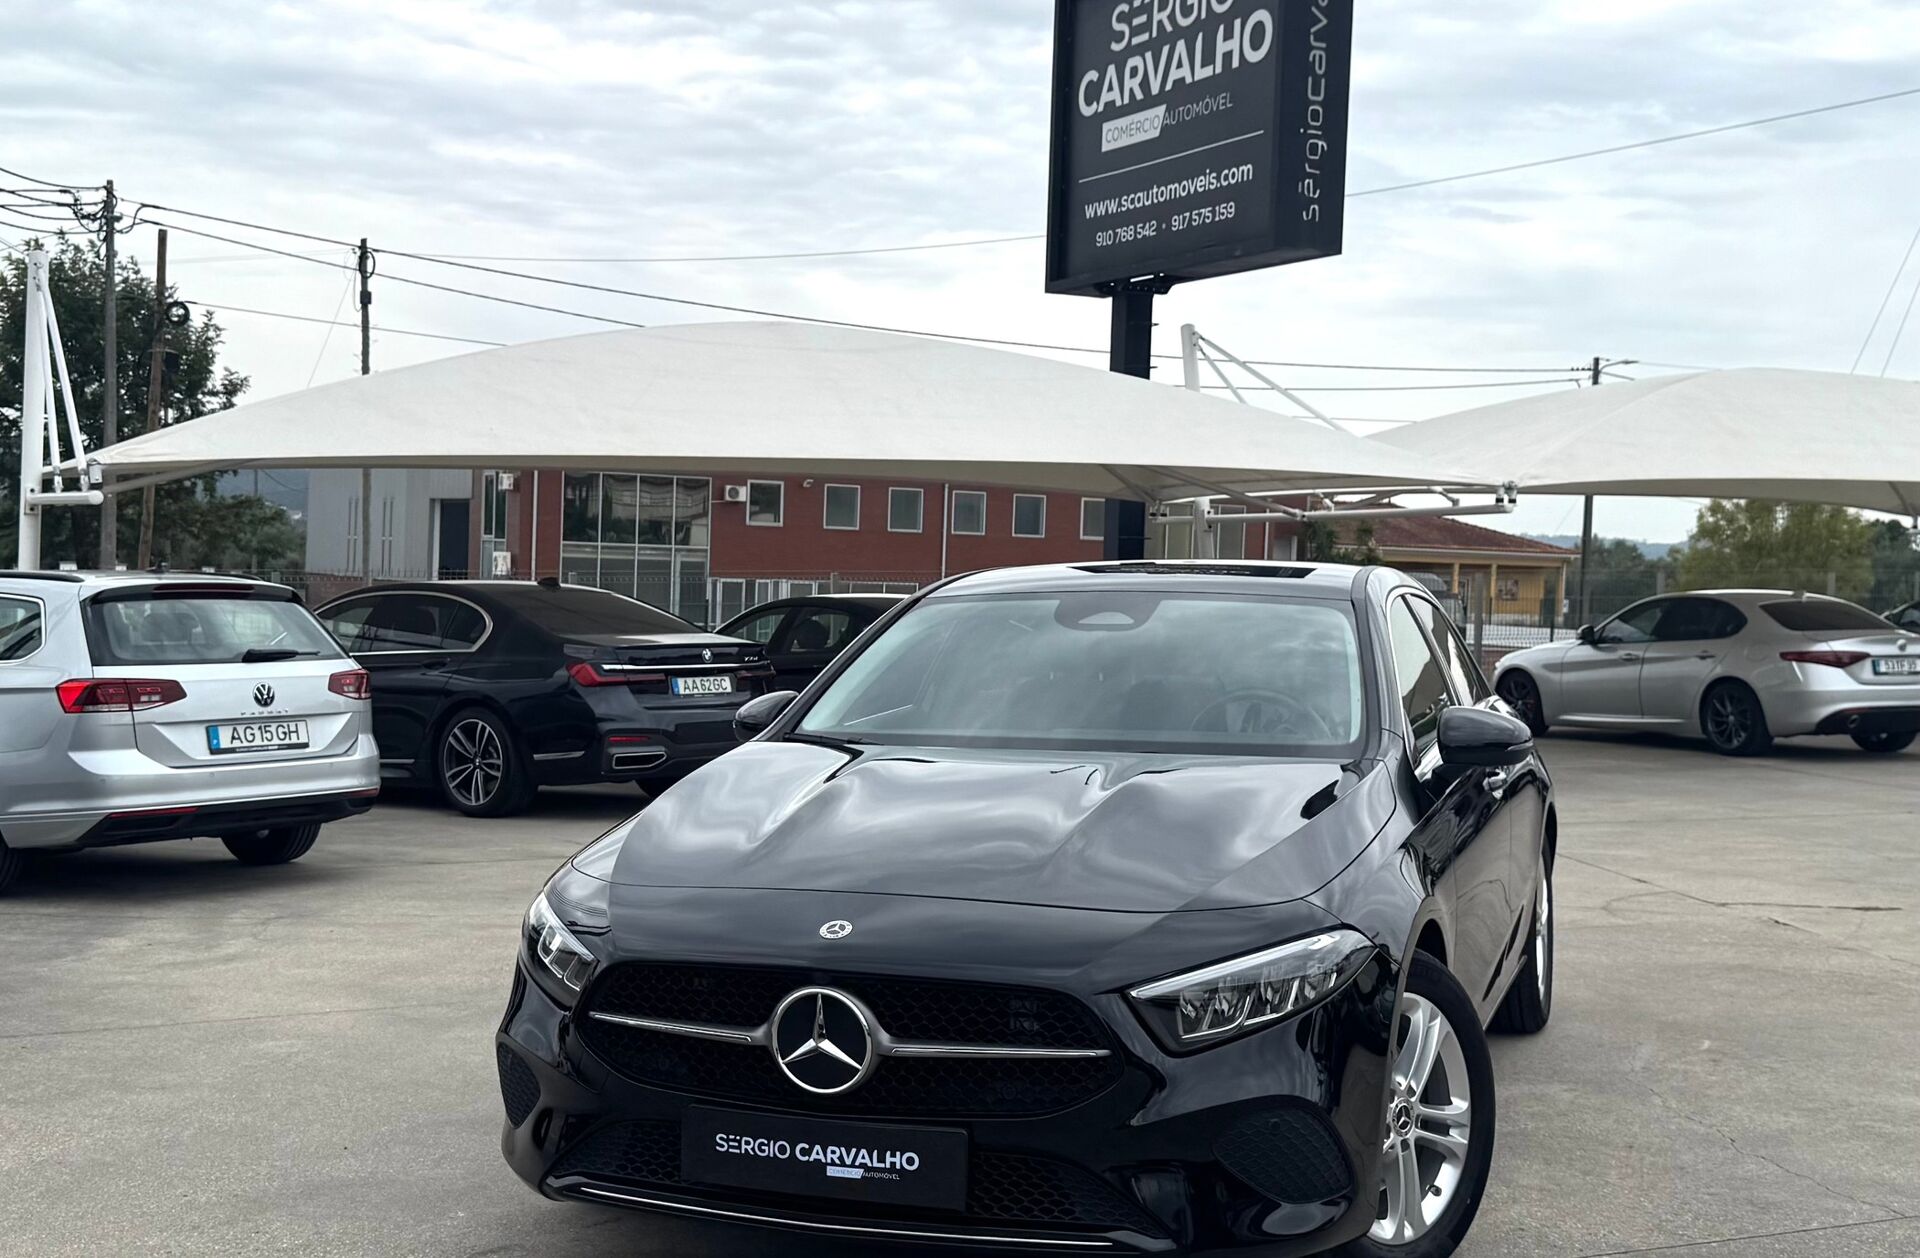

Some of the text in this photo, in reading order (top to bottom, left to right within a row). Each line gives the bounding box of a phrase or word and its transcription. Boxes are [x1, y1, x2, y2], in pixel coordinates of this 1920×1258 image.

[1078, 9, 1273, 117] CARVALHO
[1105, 91, 1234, 144] COMÉRCIO AUTOMÓVEL
[1084, 163, 1253, 219] www.scautomoveis.com
[1095, 201, 1236, 247] 910 768 542 917 575 159
[795, 1142, 920, 1171] CARVALHO
